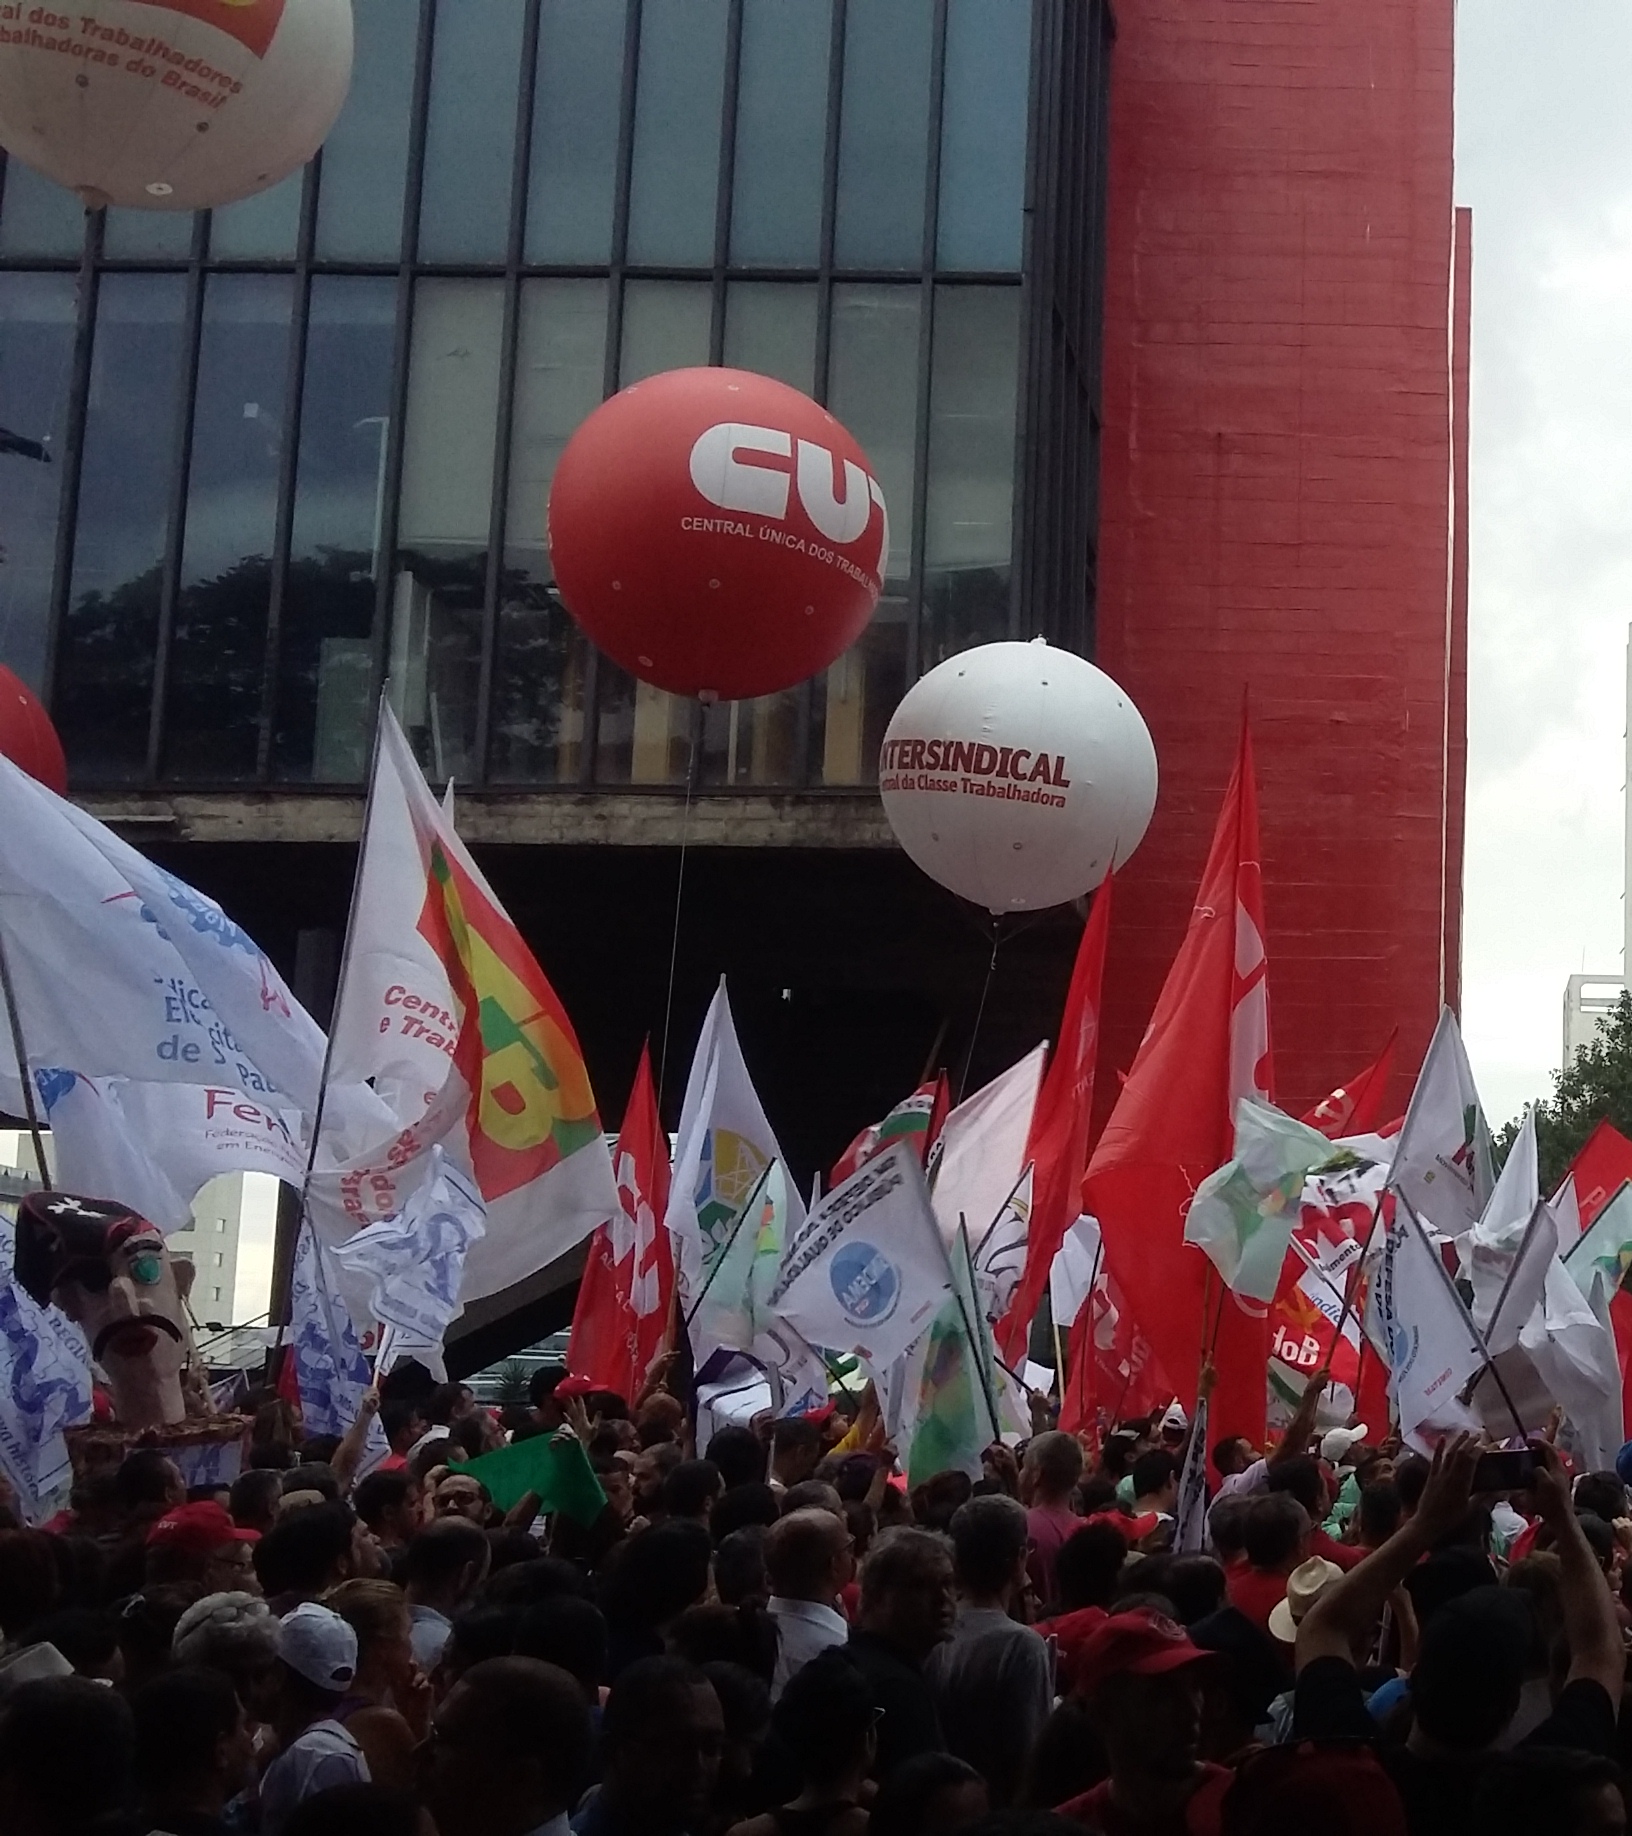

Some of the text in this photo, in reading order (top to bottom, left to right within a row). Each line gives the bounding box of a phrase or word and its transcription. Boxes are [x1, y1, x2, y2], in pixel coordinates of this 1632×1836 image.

[0, 26, 228, 109] balhadoras do Brasil
[28, 6, 70, 31] dos
[80, 16, 243, 95] Trabalhadores
[681, 516, 754, 538] CENTRAL
[759, 524, 806, 553] ÚNICA
[808, 543, 836, 564] DOS
[880, 739, 1071, 788] NTERSINDICAL
[902, 775, 915, 790] da
[917, 775, 958, 793] Classe
[961, 777, 1066, 808] Trabalhadora
[384, 985, 458, 1031] Cent
[156, 1034, 202, 1063] de
[379, 1015, 457, 1057] e Trab
